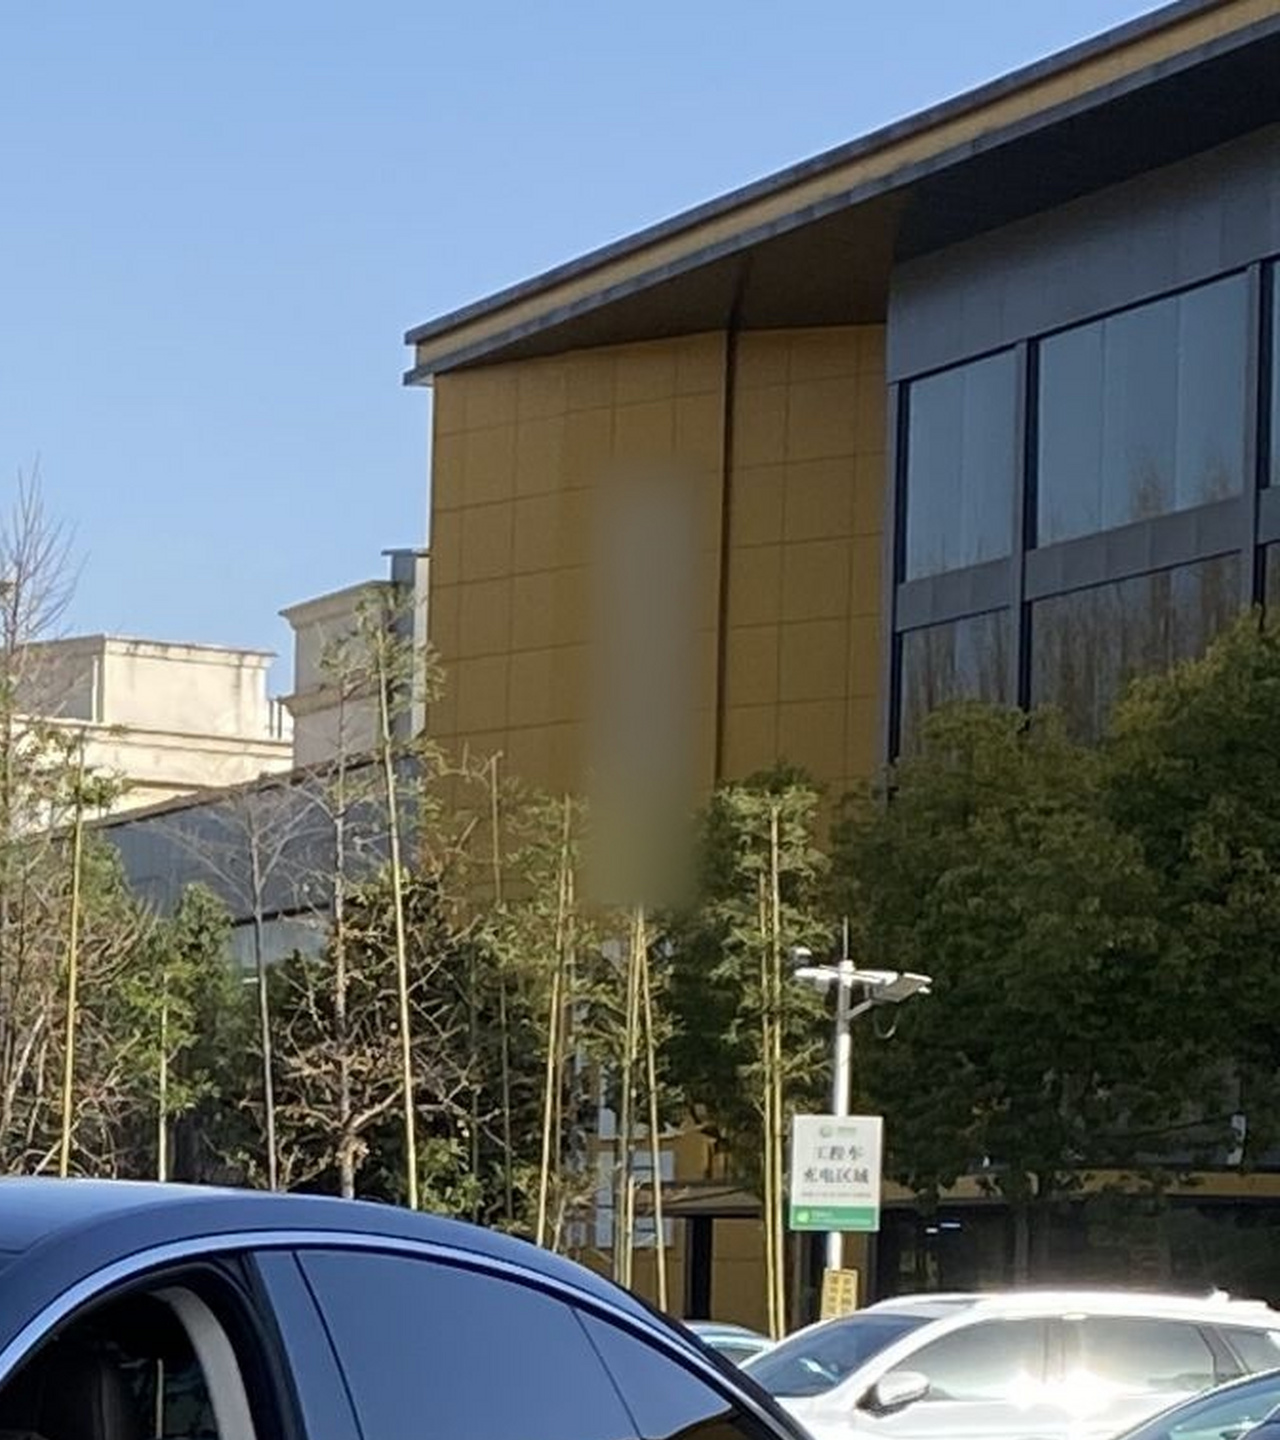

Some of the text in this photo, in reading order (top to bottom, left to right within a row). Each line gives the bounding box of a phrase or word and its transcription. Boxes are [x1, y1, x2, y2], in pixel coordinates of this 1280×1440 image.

[815, 1144, 864, 1162] 工程车
[803, 1167, 870, 1185] 充电区域
